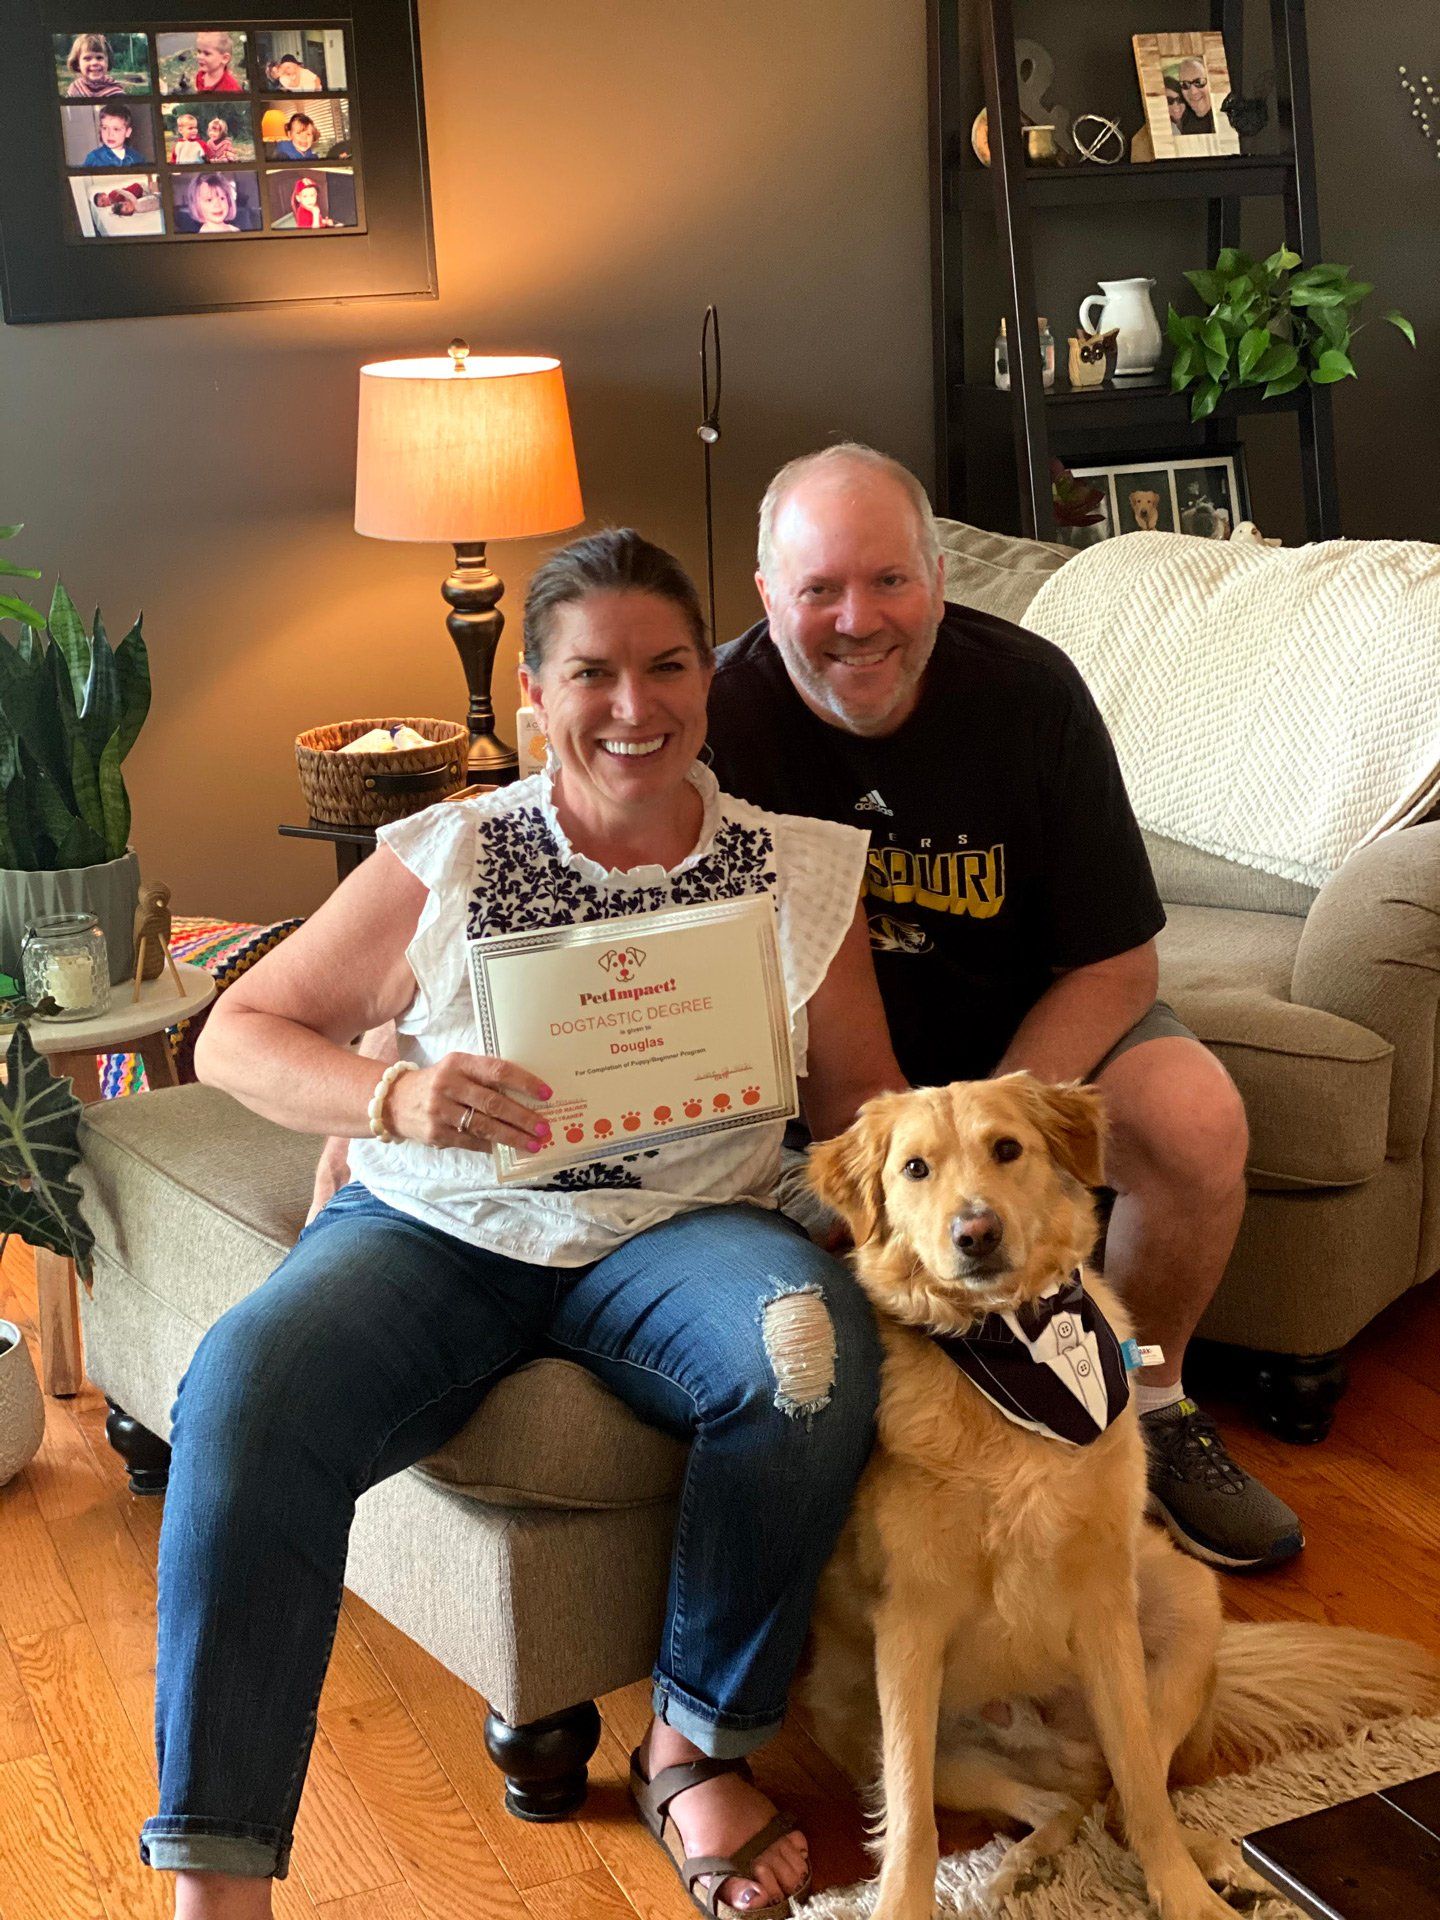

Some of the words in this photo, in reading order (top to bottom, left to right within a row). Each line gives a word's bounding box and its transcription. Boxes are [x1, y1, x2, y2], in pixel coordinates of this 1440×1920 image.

[854, 802, 894, 817] adidas
[888, 832, 968, 848] ERS
[863, 843, 1006, 919] SOURI
[579, 978, 677, 1006] PetImpact!
[550, 1009, 643, 1036] DOGTASTIC
[646, 996, 714, 1020] DEGREE
[627, 1026, 644, 1035] given
[609, 1037, 665, 1055] Douglas
[575, 1069, 586, 1077] For
[587, 1063, 623, 1075] Completion
[680, 1047, 706, 1058] Program
